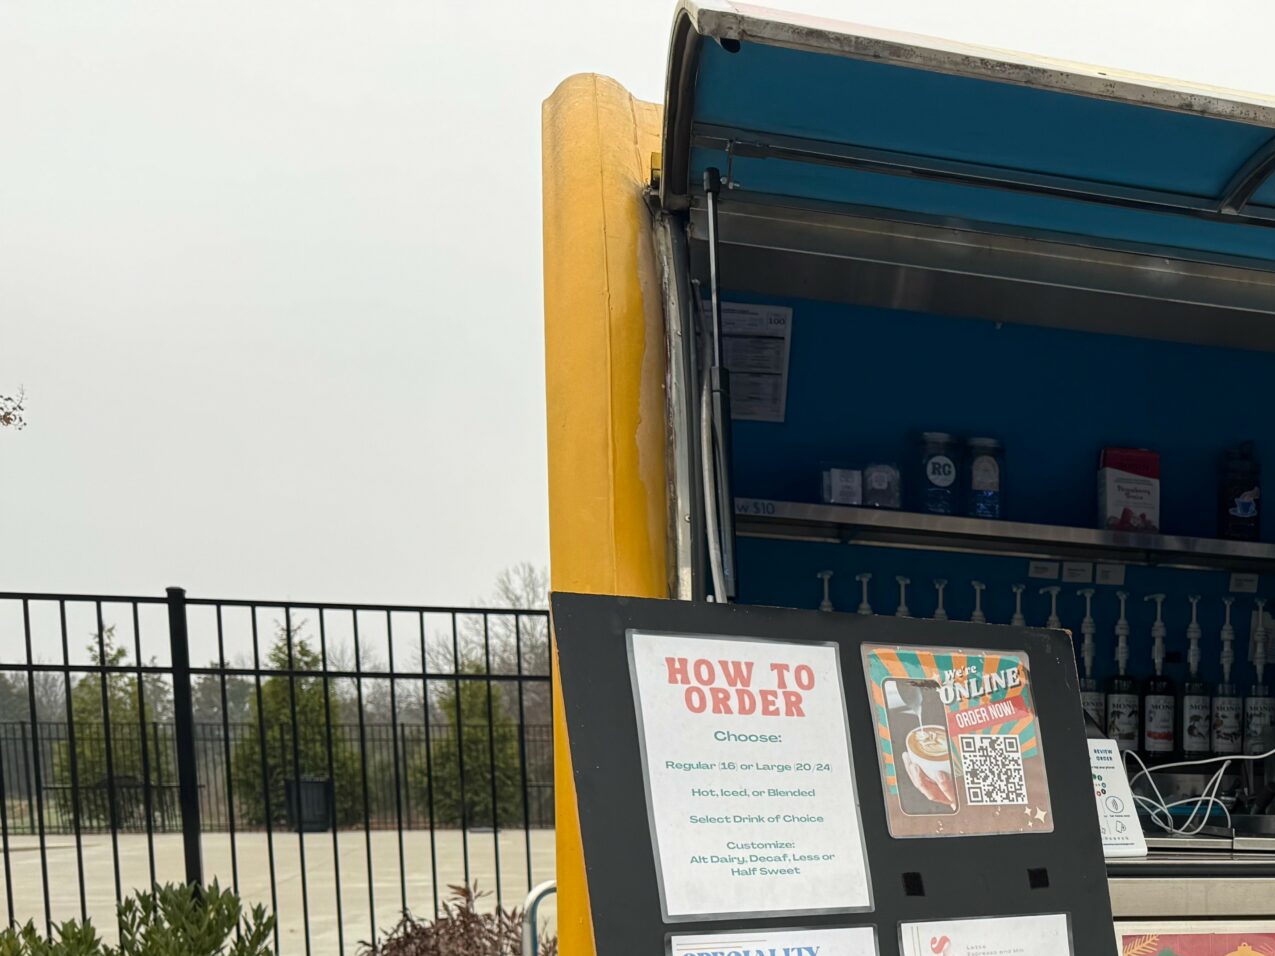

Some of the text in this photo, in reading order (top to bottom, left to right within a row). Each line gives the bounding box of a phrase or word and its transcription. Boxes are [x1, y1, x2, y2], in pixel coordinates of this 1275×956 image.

[930, 461, 952, 477] RG
[664, 657, 816, 691] HOW TO
[944, 664, 977, 681] We're
[936, 667, 1020, 704] ONLINE
[684, 686, 806, 717] ORDER
[955, 700, 1016, 730] ORDER NOW!
[714, 730, 782, 743] Choose:
[665, 760, 716, 771] Regular
[740, 763, 753, 771] or
[755, 762, 792, 773] Large
[691, 789, 719, 798] Hot,
[720, 789, 750, 798] Iced,
[767, 789, 816, 797] Blended
[690, 814, 824, 824] Select Drink of Choice
[727, 840, 796, 850] Customize:
[690, 853, 836, 865] Alt Dairy, Decaf, Less or
[731, 866, 800, 876] Half Sweet
